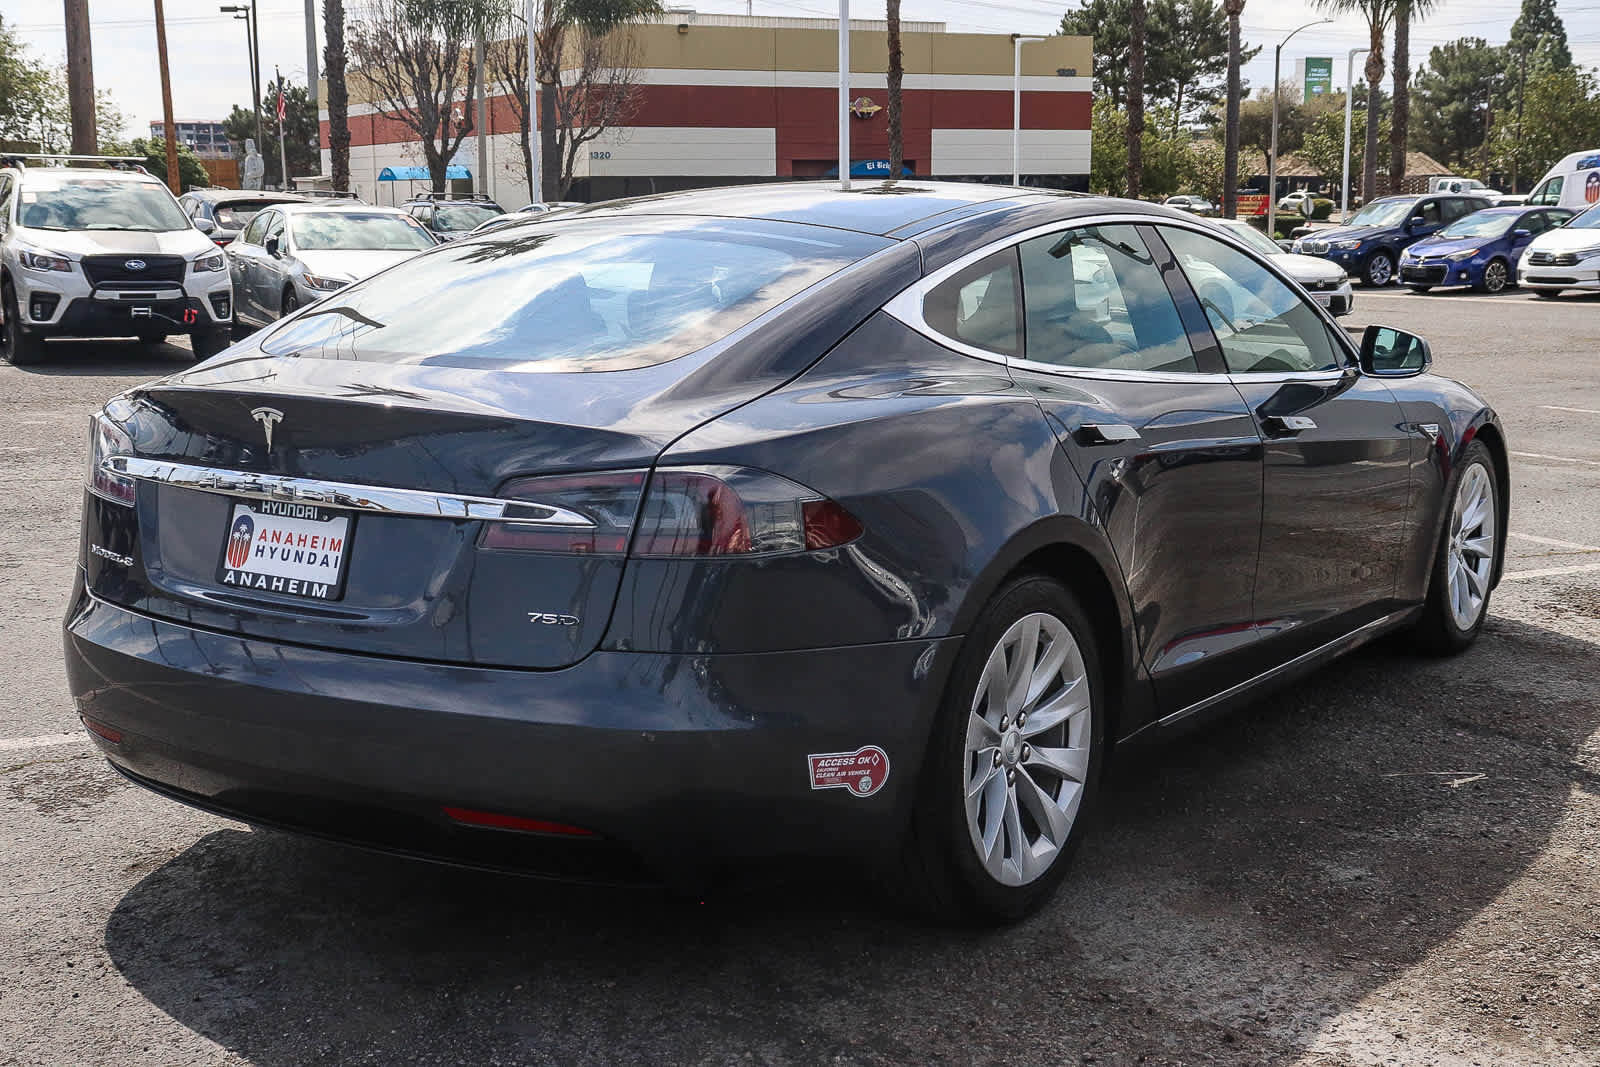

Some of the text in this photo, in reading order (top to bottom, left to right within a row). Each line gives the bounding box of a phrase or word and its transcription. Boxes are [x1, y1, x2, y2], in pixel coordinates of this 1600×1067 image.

[590, 151, 611, 160] 1320
[262, 501, 319, 520] HYUNDAI
[258, 528, 342, 552] ANAHEIM
[255, 544, 339, 568] HYUNDAI
[224, 570, 328, 598] ANAHEIM
[527, 612, 580, 625] 75D
[817, 756, 871, 767] ACCESS OK
